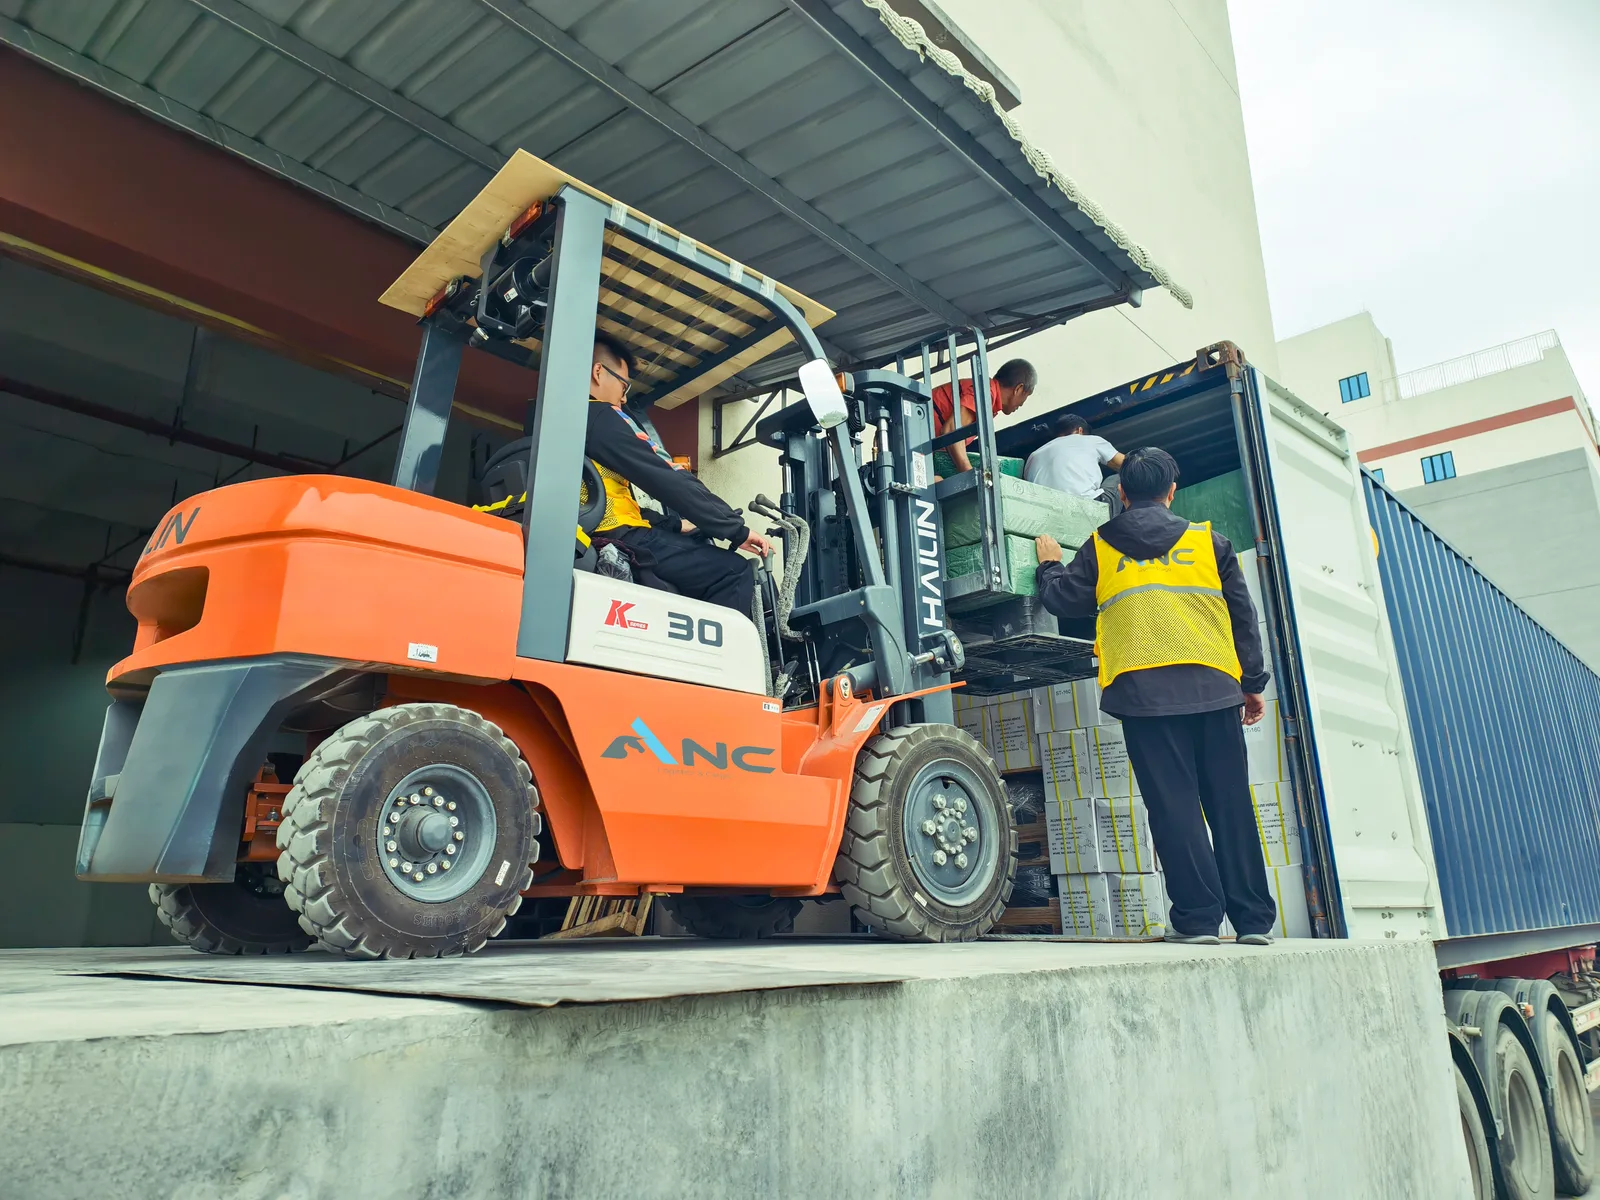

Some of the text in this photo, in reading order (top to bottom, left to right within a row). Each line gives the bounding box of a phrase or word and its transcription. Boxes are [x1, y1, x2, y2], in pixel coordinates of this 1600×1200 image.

[915, 499, 943, 628] HAILIN
[604, 599, 636, 629] K
[667, 611, 723, 648] 30
[600, 716, 776, 775] ANC
